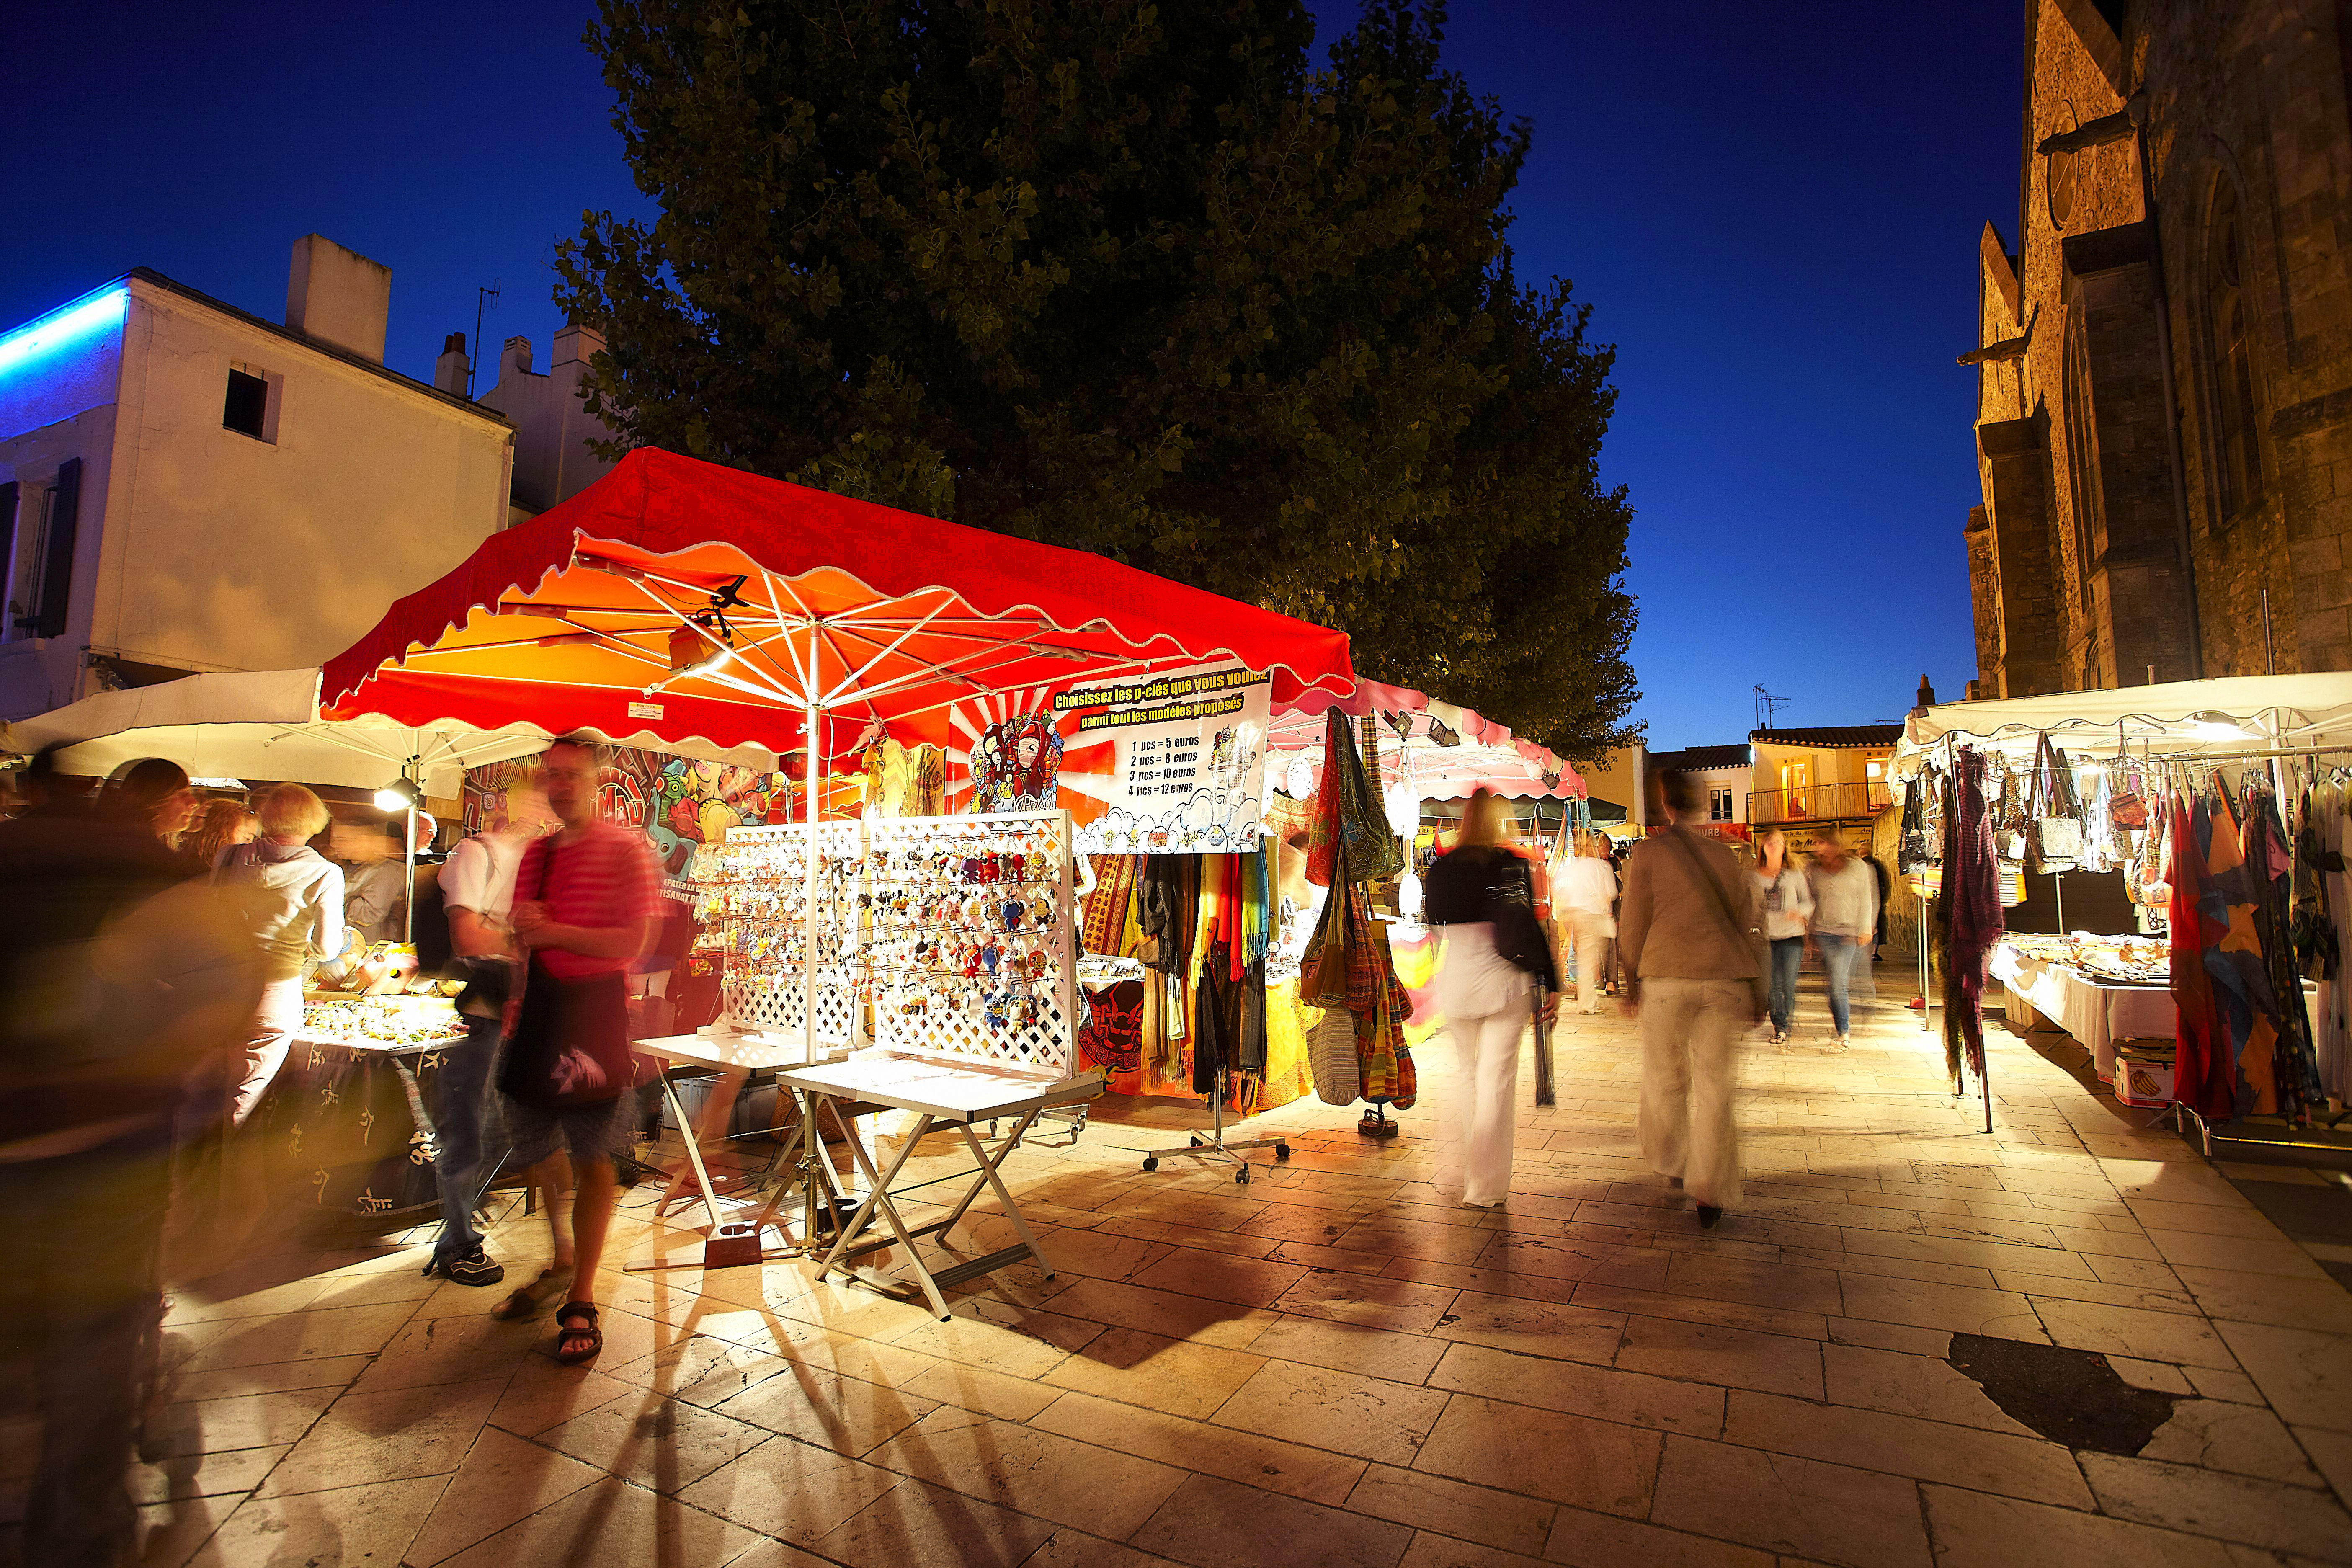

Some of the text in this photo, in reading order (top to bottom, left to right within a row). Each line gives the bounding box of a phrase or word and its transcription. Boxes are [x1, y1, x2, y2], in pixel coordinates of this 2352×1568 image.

[1055, 691, 1113, 708] Choisissez
[1114, 689, 1132, 701] les
[1134, 682, 1169, 701] p-clés
[1171, 680, 1192, 695] que
[1194, 675, 1224, 690] vous
[1081, 697, 1242, 729] parmi tout les modéles proposés
[1132, 741, 1136, 751] 1
[1141, 741, 1156, 752] pcs
[1166, 737, 1171, 748] 5
[1175, 736, 1199, 747] euros
[1131, 756, 1136, 766] 2
[1140, 756, 1154, 766] pcs
[1165, 753, 1170, 763] 8
[1174, 752, 1197, 763] euros
[1130, 771, 1135, 781] 3
[1138, 771, 1153, 781] pcs
[1163, 768, 1171, 779] 10
[1173, 767, 1196, 778] euros
[1128, 786, 1133, 795] 4
[1161, 783, 1169, 794] 12
[1171, 783, 1193, 793] euros
[663, 879, 687, 890] EPATER
[687, 883, 695, 892] LA
